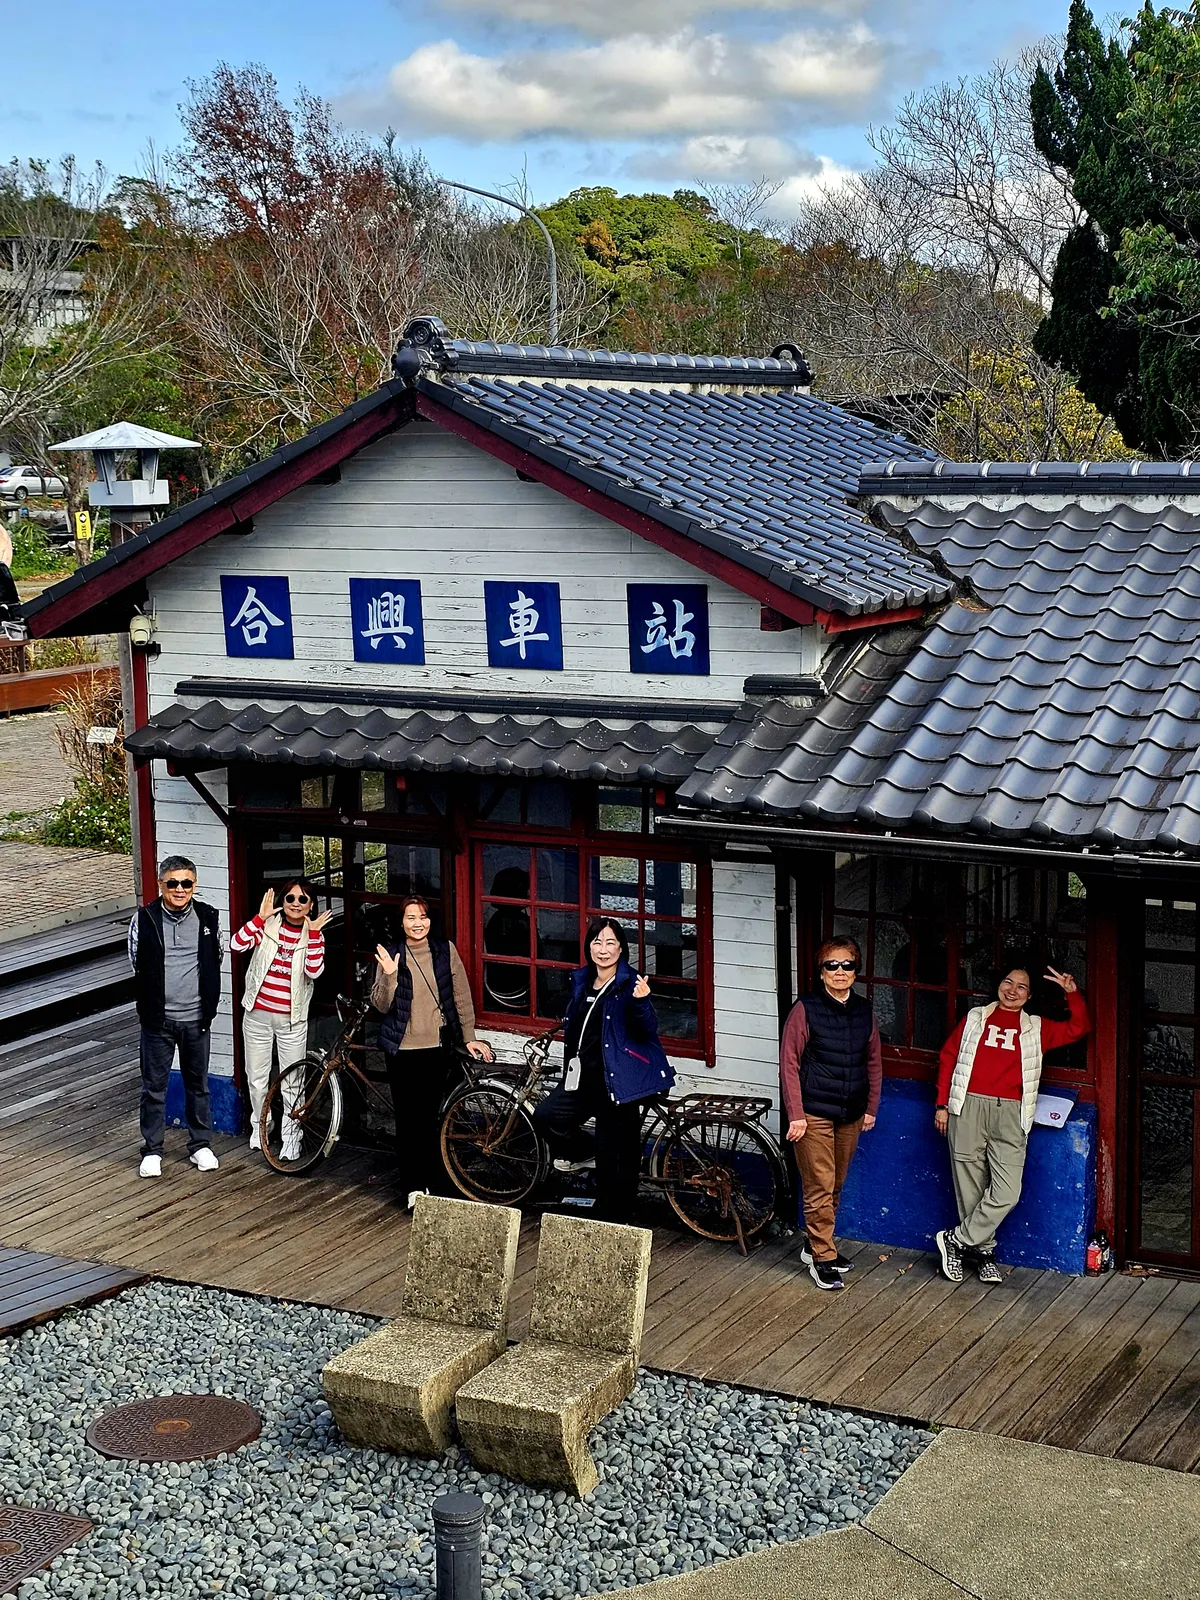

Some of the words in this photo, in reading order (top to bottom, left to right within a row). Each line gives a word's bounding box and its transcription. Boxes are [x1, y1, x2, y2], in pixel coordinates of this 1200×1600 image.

[229, 585, 697, 660] 合興車站
[985, 1024, 1018, 1051] H
